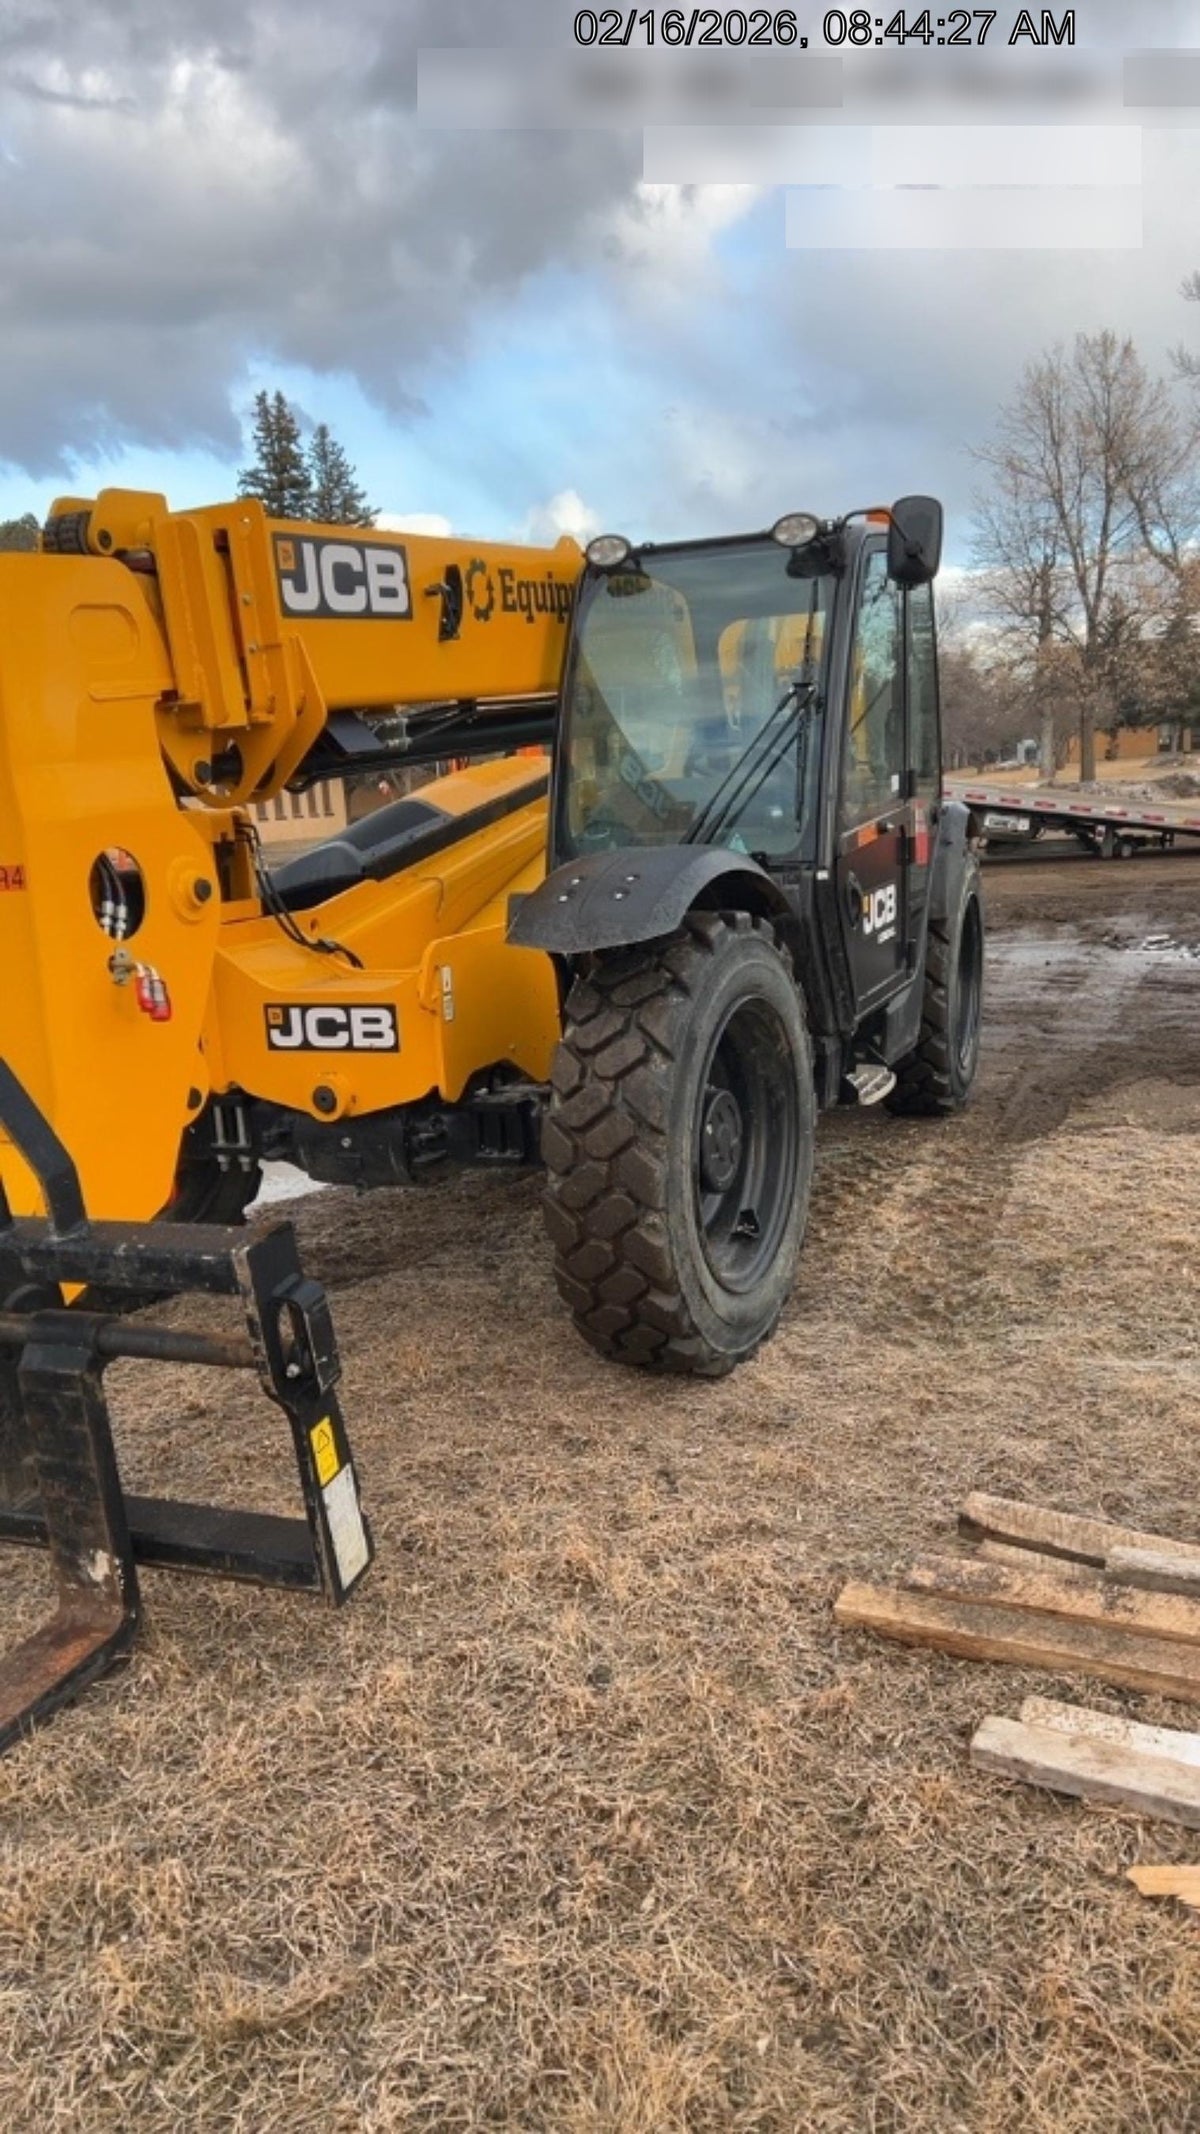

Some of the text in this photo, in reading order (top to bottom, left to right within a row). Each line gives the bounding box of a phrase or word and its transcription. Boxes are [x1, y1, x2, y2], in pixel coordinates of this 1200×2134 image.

[282, 543, 409, 612] JCB
[863, 884, 896, 935] JCB
[270, 1007, 396, 1048] JCB
